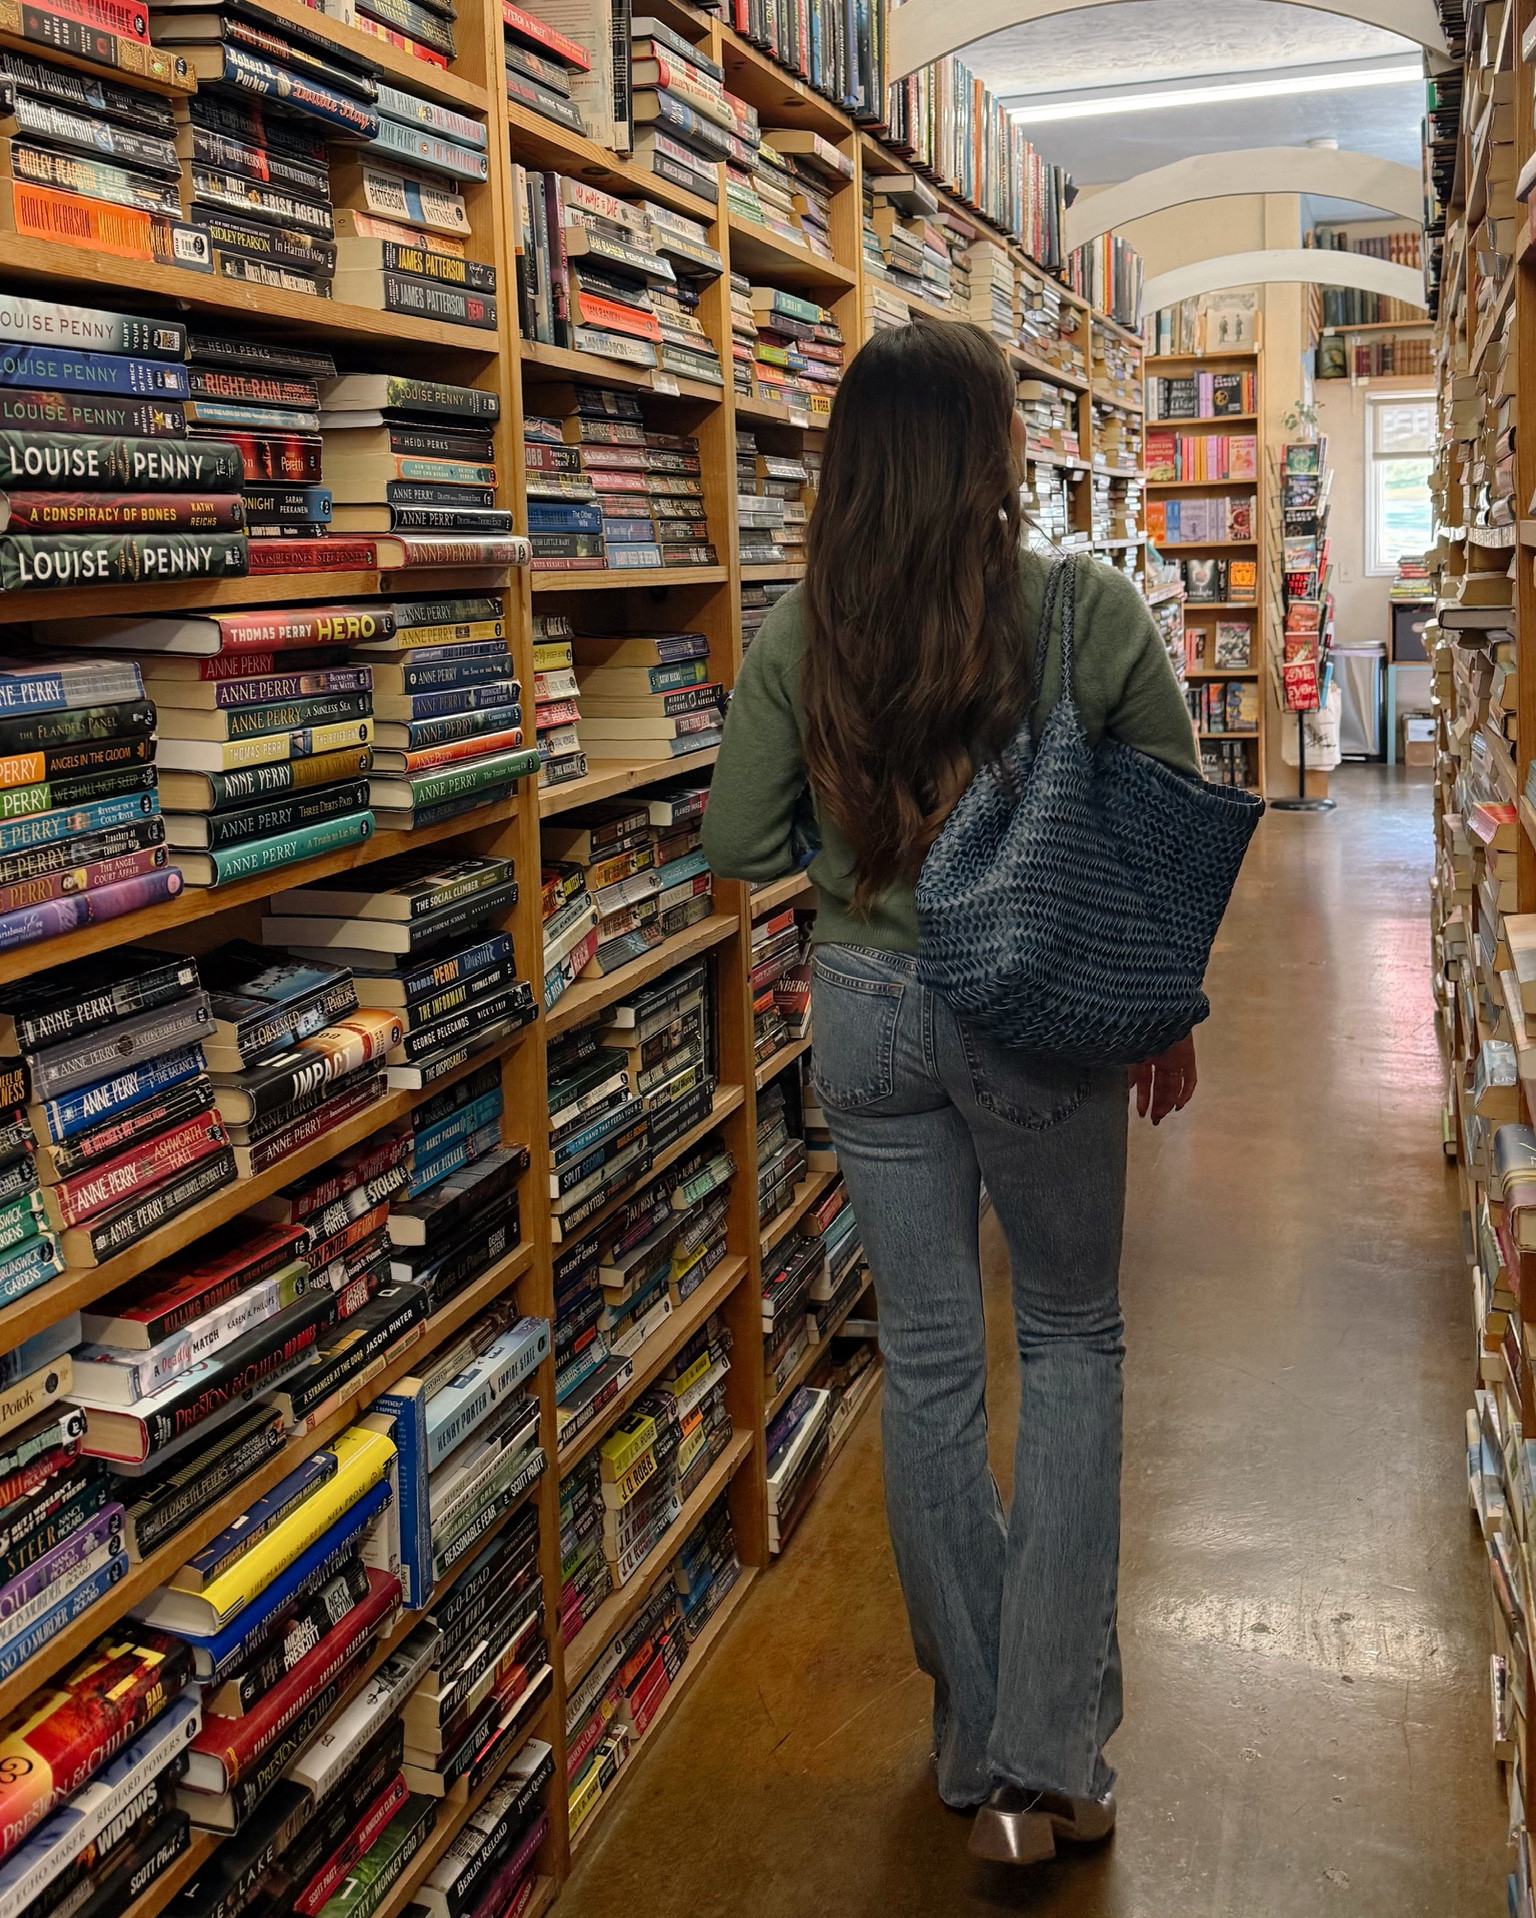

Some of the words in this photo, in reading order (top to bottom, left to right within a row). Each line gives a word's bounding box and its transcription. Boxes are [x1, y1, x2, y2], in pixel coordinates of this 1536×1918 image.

[62, 23, 70, 44] CLUB
[235, 69, 269, 93] Parker
[269, 194, 293, 216] RISK
[295, 202, 325, 225] AGENT
[426, 190, 450, 207] SILENT
[21, 194, 50, 231] RIDLEY
[53, 203, 92, 239] PEARSON
[210, 226, 238, 243] RIDLEY
[238, 233, 271, 252] PEARSON
[275, 238, 283, 250] In
[284, 242, 310, 259] Harm's
[311, 249, 326, 264] Way
[398, 247, 423, 273] JAMES
[425, 250, 466, 282] PATTERSON
[400, 283, 424, 309] JAMES
[427, 285, 465, 317] PATTERSON
[60, 318, 114, 339] PENNY
[64, 361, 117, 383] PENNY
[205, 374, 245, 395] RIGHT
[401, 387, 432, 401] LOUISE
[435, 392, 464, 405] PENNY
[4, 401, 67, 421] LOUISE
[72, 406, 126, 425] PENNY
[427, 441, 448, 449] PERKS
[8, 446, 99, 476] LOUISE
[134, 452, 203, 479] PENNY
[191, 502, 214, 513] KATHY
[280, 505, 308, 515] PEKKANEN
[393, 488, 413, 498] ANNE
[414, 489, 434, 500] PERRY
[30, 508, 38, 522] A
[43, 507, 119, 522] CONSPIRACY
[124, 508, 137, 521] OF
[141, 507, 176, 521] BONES
[190, 516, 217, 526] REICHS
[401, 511, 427, 525] ANNE
[430, 513, 454, 525] PERRY
[18, 551, 109, 581] LOUISE
[143, 547, 212, 574] PENNY
[231, 626, 276, 642] THOMAS
[279, 625, 312, 639] PERRY
[316, 615, 375, 641] HERO
[206, 658, 238, 677] ANNE
[242, 655, 273, 674] PERRY
[221, 684, 256, 703] ANNE
[260, 679, 297, 697] PERRY
[266, 708, 302, 727] PERRY
[50, 756, 78, 770] ANGELS
[80, 756, 88, 765] IN
[90, 752, 102, 762] THE
[104, 748, 131, 761] GLOOM
[230, 745, 260, 761] THOMAS
[224, 773, 255, 797] ANNE
[259, 765, 290, 790] PERRY
[419, 782, 446, 801] ANNE
[449, 773, 477, 793] PERRY
[4, 788, 50, 816] PERRY
[675, 805, 690, 817] FLAWED
[220, 817, 254, 839] ANNE
[258, 808, 292, 830] PERRY
[224, 853, 258, 877] ANNE
[263, 841, 297, 865] PERRY
[416, 900, 430, 912] THE
[430, 889, 452, 908] SOCIAL
[454, 880, 479, 898] CLIMBER
[408, 974, 434, 994] Thomas
[434, 960, 460, 987] PERRY
[76, 994, 113, 1023] PERRY
[419, 1006, 431, 1022] THE
[432, 986, 467, 1014] INFORMANT
[257, 1012, 300, 1045] OBSESSED
[413, 1029, 436, 1050] GEORGE
[437, 1016, 469, 1039] PELECANOS
[293, 1049, 350, 1098] IMPACT
[84, 1088, 113, 1117] ANNE
[112, 1071, 139, 1097] PERRY
[153, 1124, 202, 1160] ASHWORTH
[267, 1133, 292, 1161] ANNE
[294, 1115, 321, 1143] PERRY
[575, 1133, 585, 1147] THE
[586, 1129, 599, 1142] HAND
[599, 1122, 609, 1133] THAT
[169, 1148, 194, 1169] HALL
[78, 1181, 109, 1212] ANNE
[109, 1163, 138, 1190] PERRY
[563, 1165, 581, 1188] SPLIT
[560, 1256, 581, 1278] SILENT
[582, 1242, 598, 1262] GIRLS
[164, 1304, 200, 1333] KILLING
[154, 1365, 160, 1377] A
[192, 1329, 219, 1353] MATCH
[304, 1395, 308, 1404] A
[309, 1374, 333, 1401] STRANGER
[334, 1369, 341, 1380] AT
[341, 1360, 351, 1373] THE
[351, 1349, 364, 1365] DOOR
[366, 1329, 388, 1353] JASON
[388, 1309, 412, 1334] PINTER
[175, 1384, 228, 1432] PRESTON
[438, 1425, 459, 1452] HENRY
[461, 1393, 487, 1428] PORTER
[498, 1363, 518, 1392] EMPIRE
[520, 1345, 535, 1370] STATE
[510, 1475, 528, 1497] SCOTT
[527, 1455, 544, 1482] PRATT
[633, 1453, 653, 1485] ROBB
[11, 1517, 28, 1537] BUT
[444, 1528, 484, 1568] REASONABLE
[482, 1505, 497, 1530] FEAR
[284, 1616, 314, 1652] MICHAEL
[284, 1626, 320, 1673] PRESCOTT
[88, 1720, 134, 1772] CHILD
[50, 1828, 86, 1869] MAKER
[96, 1775, 141, 1823] RICHARD
[144, 1735, 180, 1779] POWERS
[97, 1781, 157, 1857] WIDOWS
[375, 1857, 402, 1895] MONKEY
[403, 1837, 417, 1862] GOD
[457, 1856, 482, 1897] BERLIN
[482, 1822, 507, 1860] RELOAD
[130, 1859, 156, 1894] SCOTT
